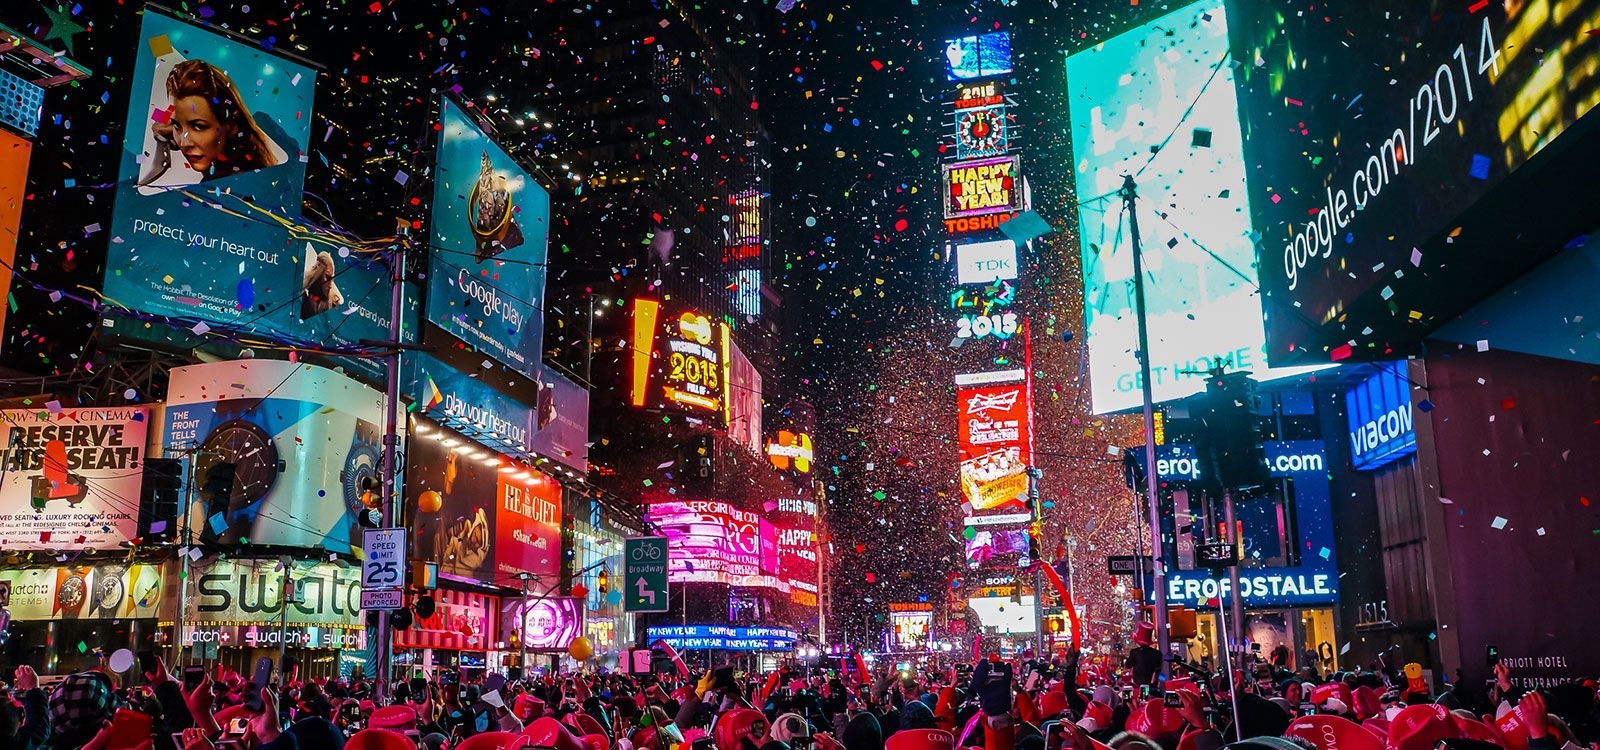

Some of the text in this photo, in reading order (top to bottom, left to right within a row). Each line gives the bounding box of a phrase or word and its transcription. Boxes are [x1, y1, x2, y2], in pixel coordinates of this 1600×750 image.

[955, 96, 1003, 109] TOSHBA
[1284, 16, 1501, 290] google.com/2014
[951, 163, 1012, 184] HAPPY
[962, 177, 1003, 196] NEW
[956, 190, 1009, 210] YEAR!
[944, 214, 1010, 234] TOSHI
[134, 218, 279, 265] protect your heart out
[975, 260, 1010, 270] TDK
[161, 294, 175, 302] own
[229, 307, 242, 317] Play
[459, 268, 523, 333] Google play
[348, 300, 377, 322] comand
[377, 316, 390, 328] your
[956, 313, 1017, 337] 2015
[670, 352, 718, 389] 2015
[80, 409, 140, 421] CINEMA
[172, 411, 189, 420] THE
[446, 391, 526, 444] play your heart out
[171, 420, 200, 430] FRONT
[8, 424, 125, 447] RESERVE
[171, 430, 196, 440] TELLS
[170, 440, 187, 450] THE
[0, 446, 139, 471] HIS SEAT!
[169, 450, 189, 460] TIME
[504, 483, 522, 514] HE
[532, 496, 557, 527] GIFT
[371, 542, 396, 550] SPEED
[513, 529, 547, 550] #ShareeGift
[780, 529, 812, 547] HAPPY
[371, 551, 394, 559] IMIT
[367, 561, 398, 584] 25
[628, 565, 665, 574] Broadway
[986, 577, 1014, 585] SONY
[1151, 574, 1337, 600] ÉROPOSTALE.
[889, 602, 933, 611] TOSHIBA
[1358, 600, 1387, 623] 1515
[245, 630, 301, 643] swatch
[323, 634, 357, 644] swatch
[658, 627, 673, 635] NEW
[673, 626, 697, 635] YEAR!
[747, 628, 770, 636] HAPPY
[730, 639, 748, 648] NEW
[1538, 656, 1568, 668] HOTEL
